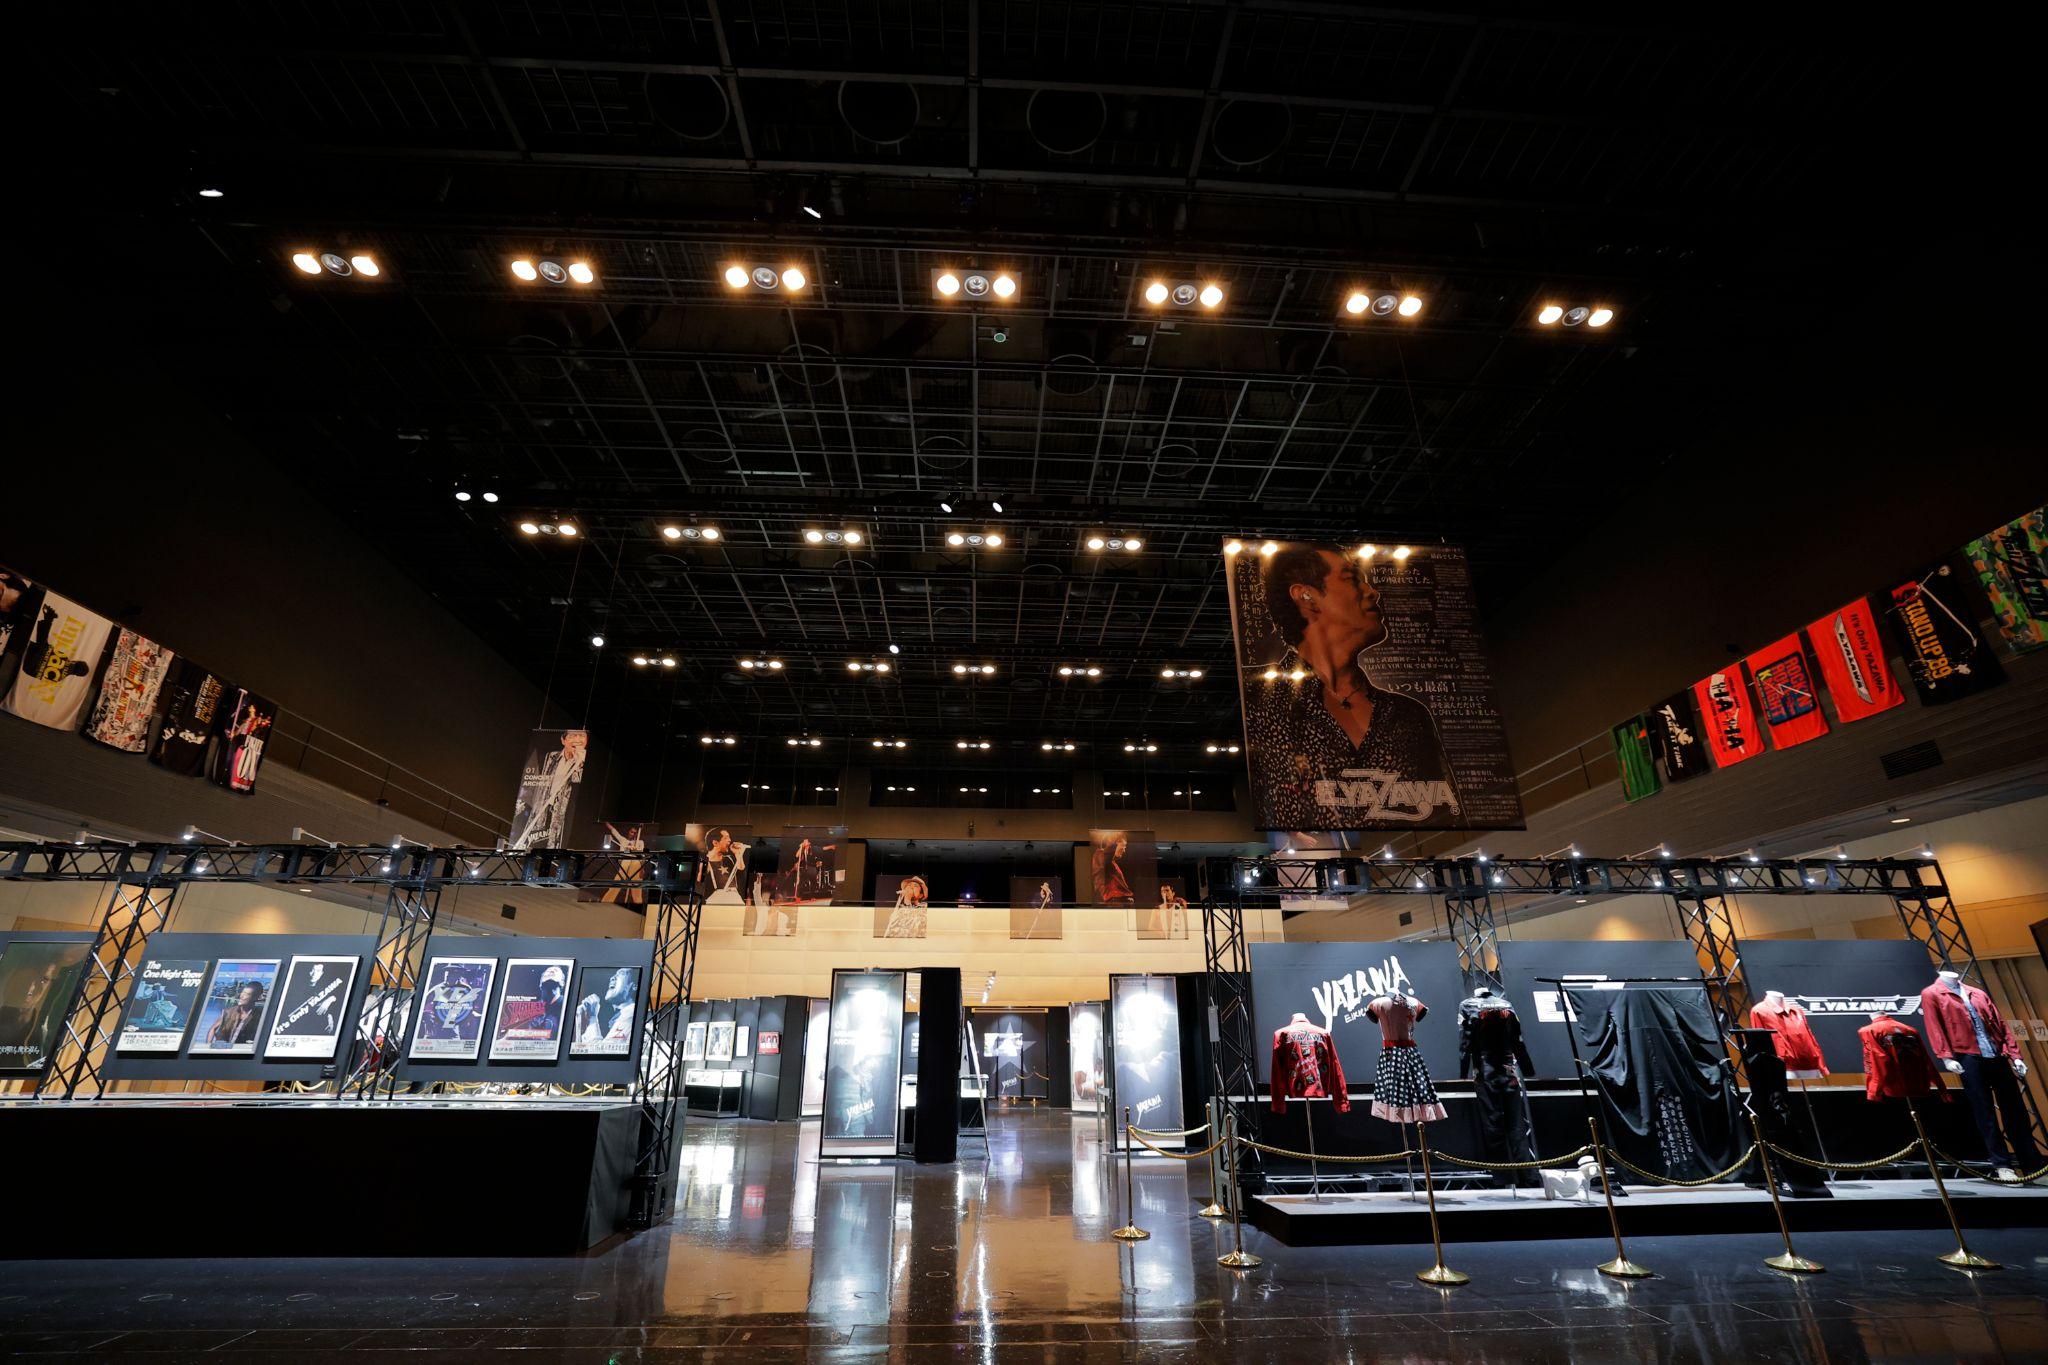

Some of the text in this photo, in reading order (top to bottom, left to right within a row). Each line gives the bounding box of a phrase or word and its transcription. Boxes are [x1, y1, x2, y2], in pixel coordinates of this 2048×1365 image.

[1856, 629, 1869, 651] Only
[1865, 651, 1886, 693] YAZAWA
[147, 961, 162, 970] The
[143, 969, 204, 980] One Night Show
[181, 979, 202, 987] 1979
[276, 977, 343, 1034] It's Only YAZAWA
[1809, 1001, 1898, 1011] E.YAZAWA
